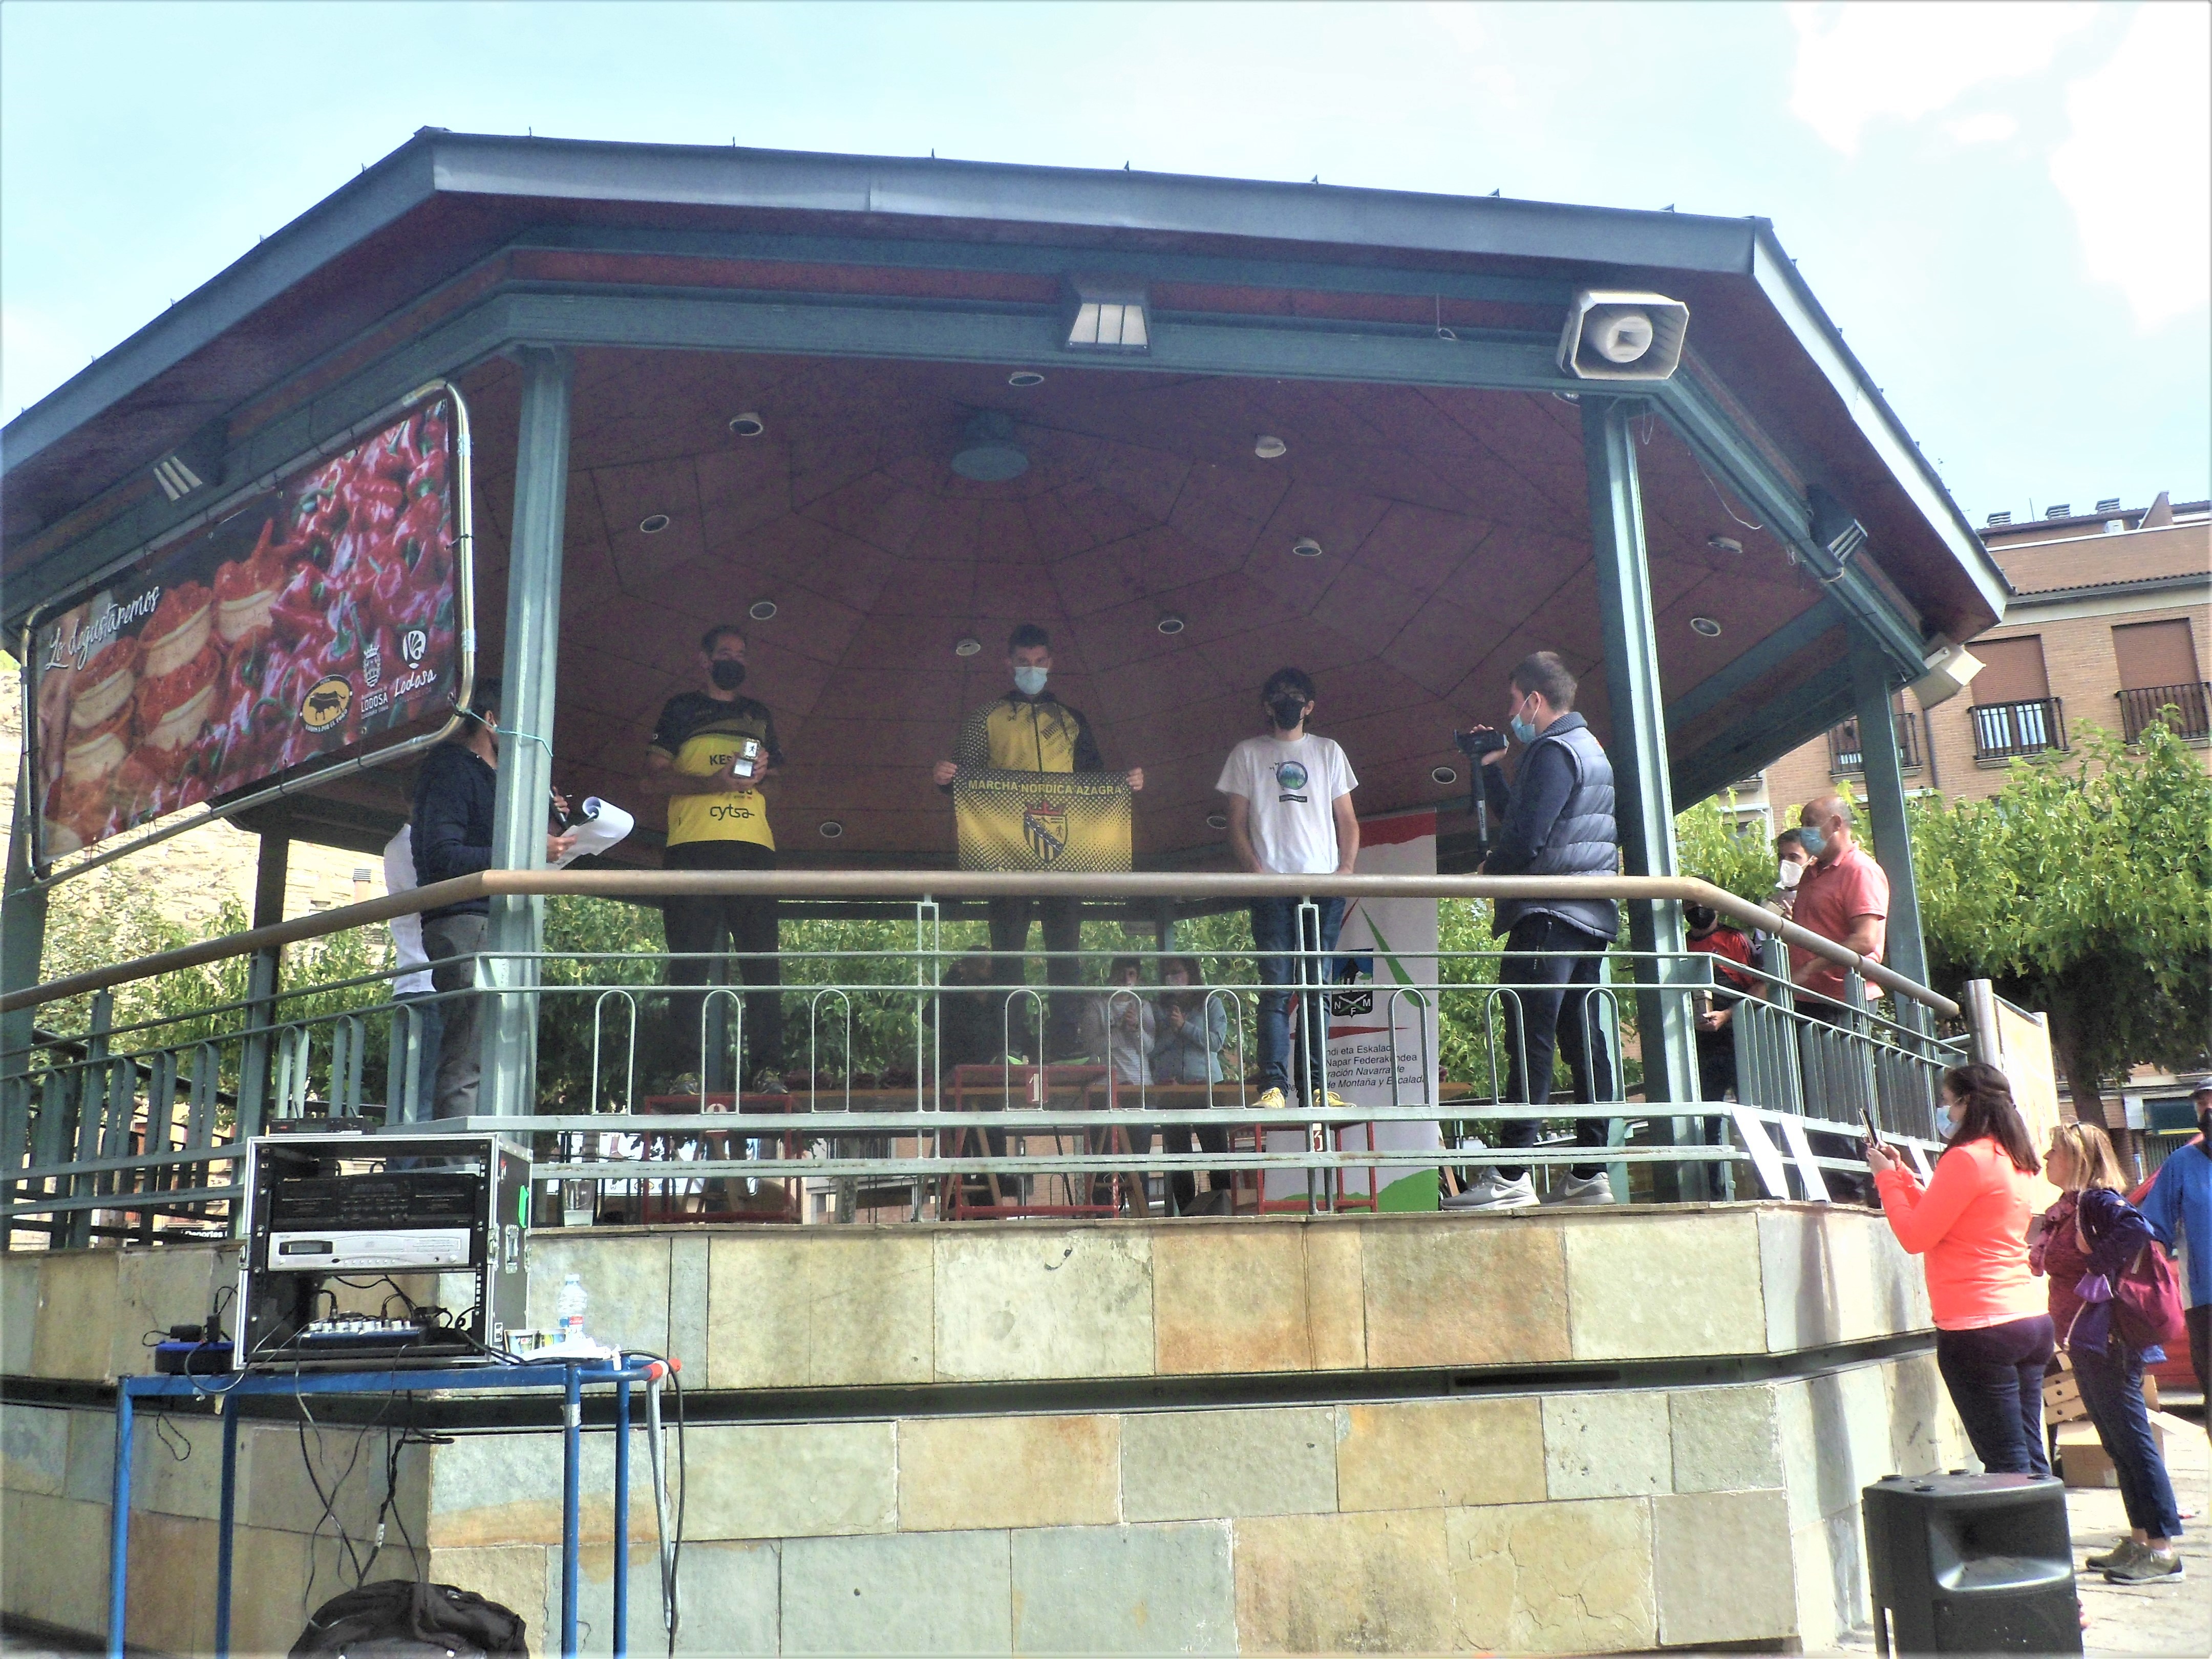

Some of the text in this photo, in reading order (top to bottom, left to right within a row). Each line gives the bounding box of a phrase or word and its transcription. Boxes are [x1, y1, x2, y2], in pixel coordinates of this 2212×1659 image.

[69, 586, 160, 670] degustaremos
[394, 669, 437, 697] Lodosa
[361, 692, 388, 713] LODOSA
[968, 779, 1122, 795] MARCHA NORDICA AZAGRA
[710, 803, 755, 821] cytsa
[1354, 1054, 1417, 1065] Federakndea
[1356, 1067, 1391, 1075] Navarra
[1338, 1078, 1376, 1088] Montaña
[1378, 1079, 1385, 1087] y
